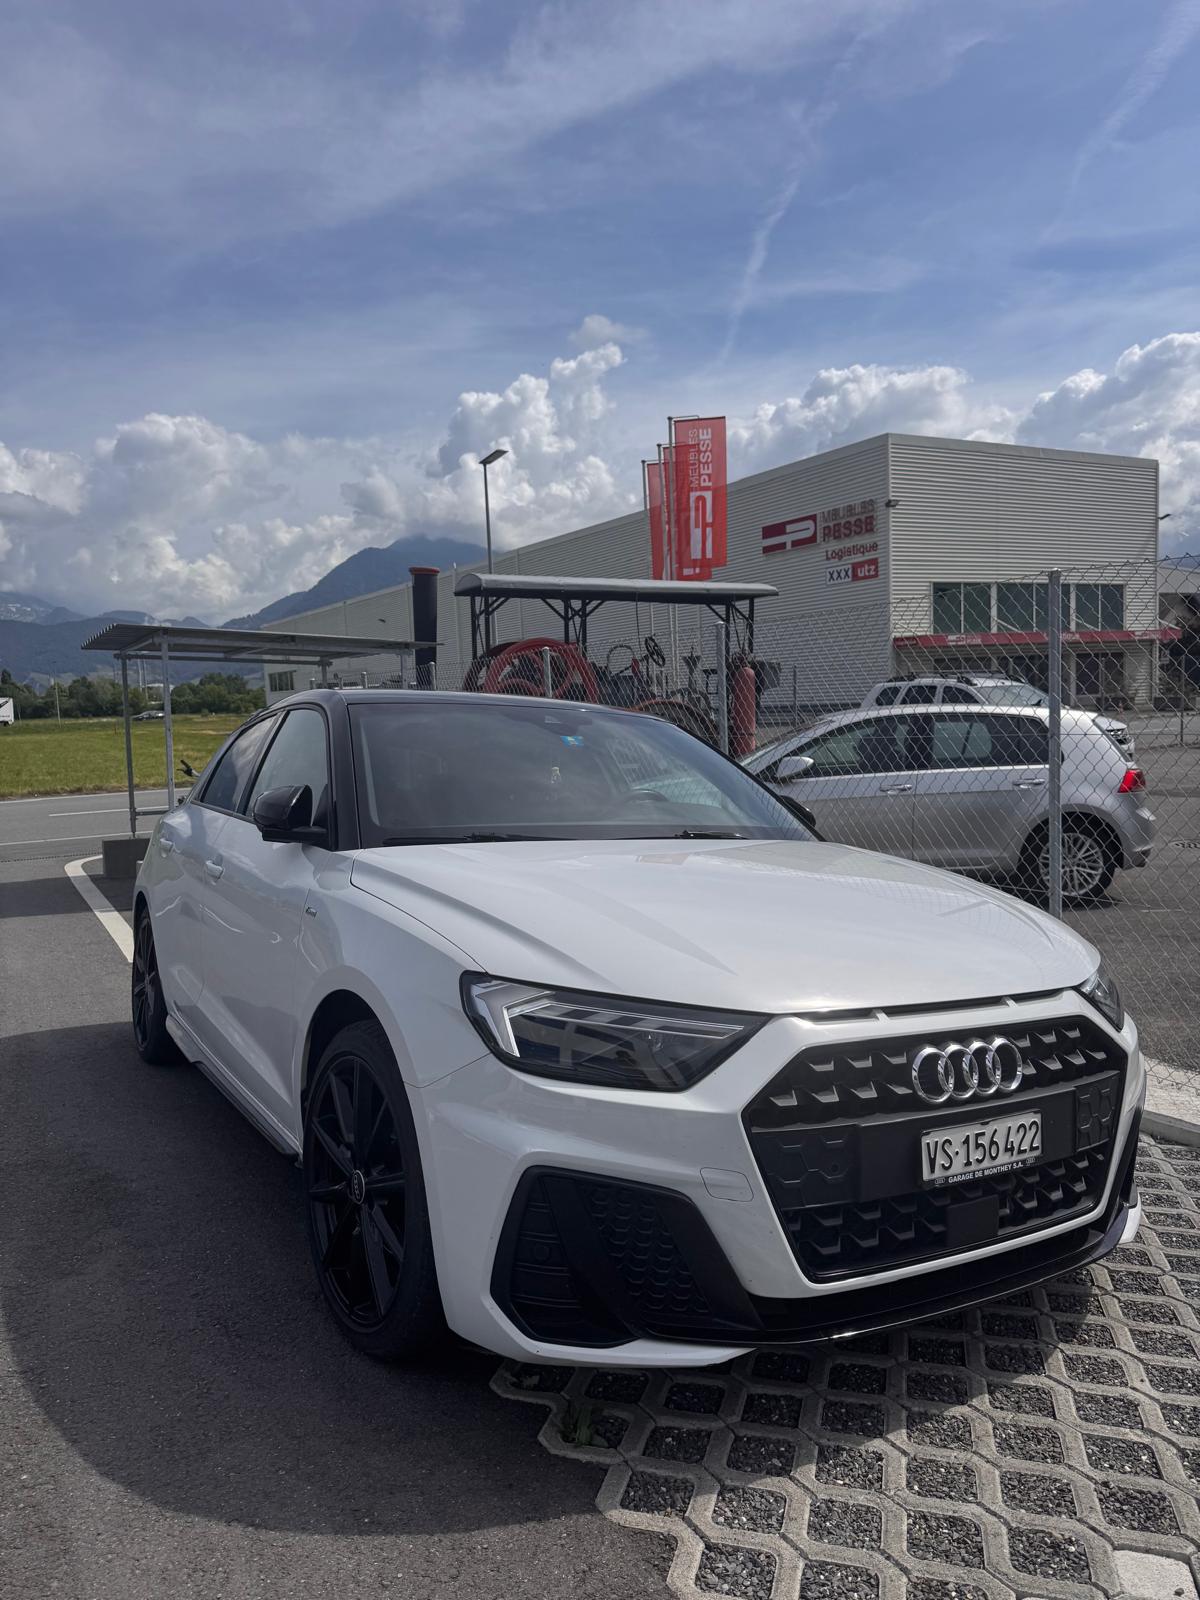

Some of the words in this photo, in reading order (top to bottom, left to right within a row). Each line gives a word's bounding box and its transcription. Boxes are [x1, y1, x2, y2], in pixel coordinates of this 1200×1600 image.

[699, 427, 712, 487] PESSE
[822, 515, 875, 542] PESSE
[825, 542, 878, 561] Logistique
[948, 1173, 974, 1184] GARAGE
[974, 1170, 983, 1179] DE
[984, 1163, 1012, 1176] MONTHEY
[1012, 1161, 1024, 1169] S.A.
